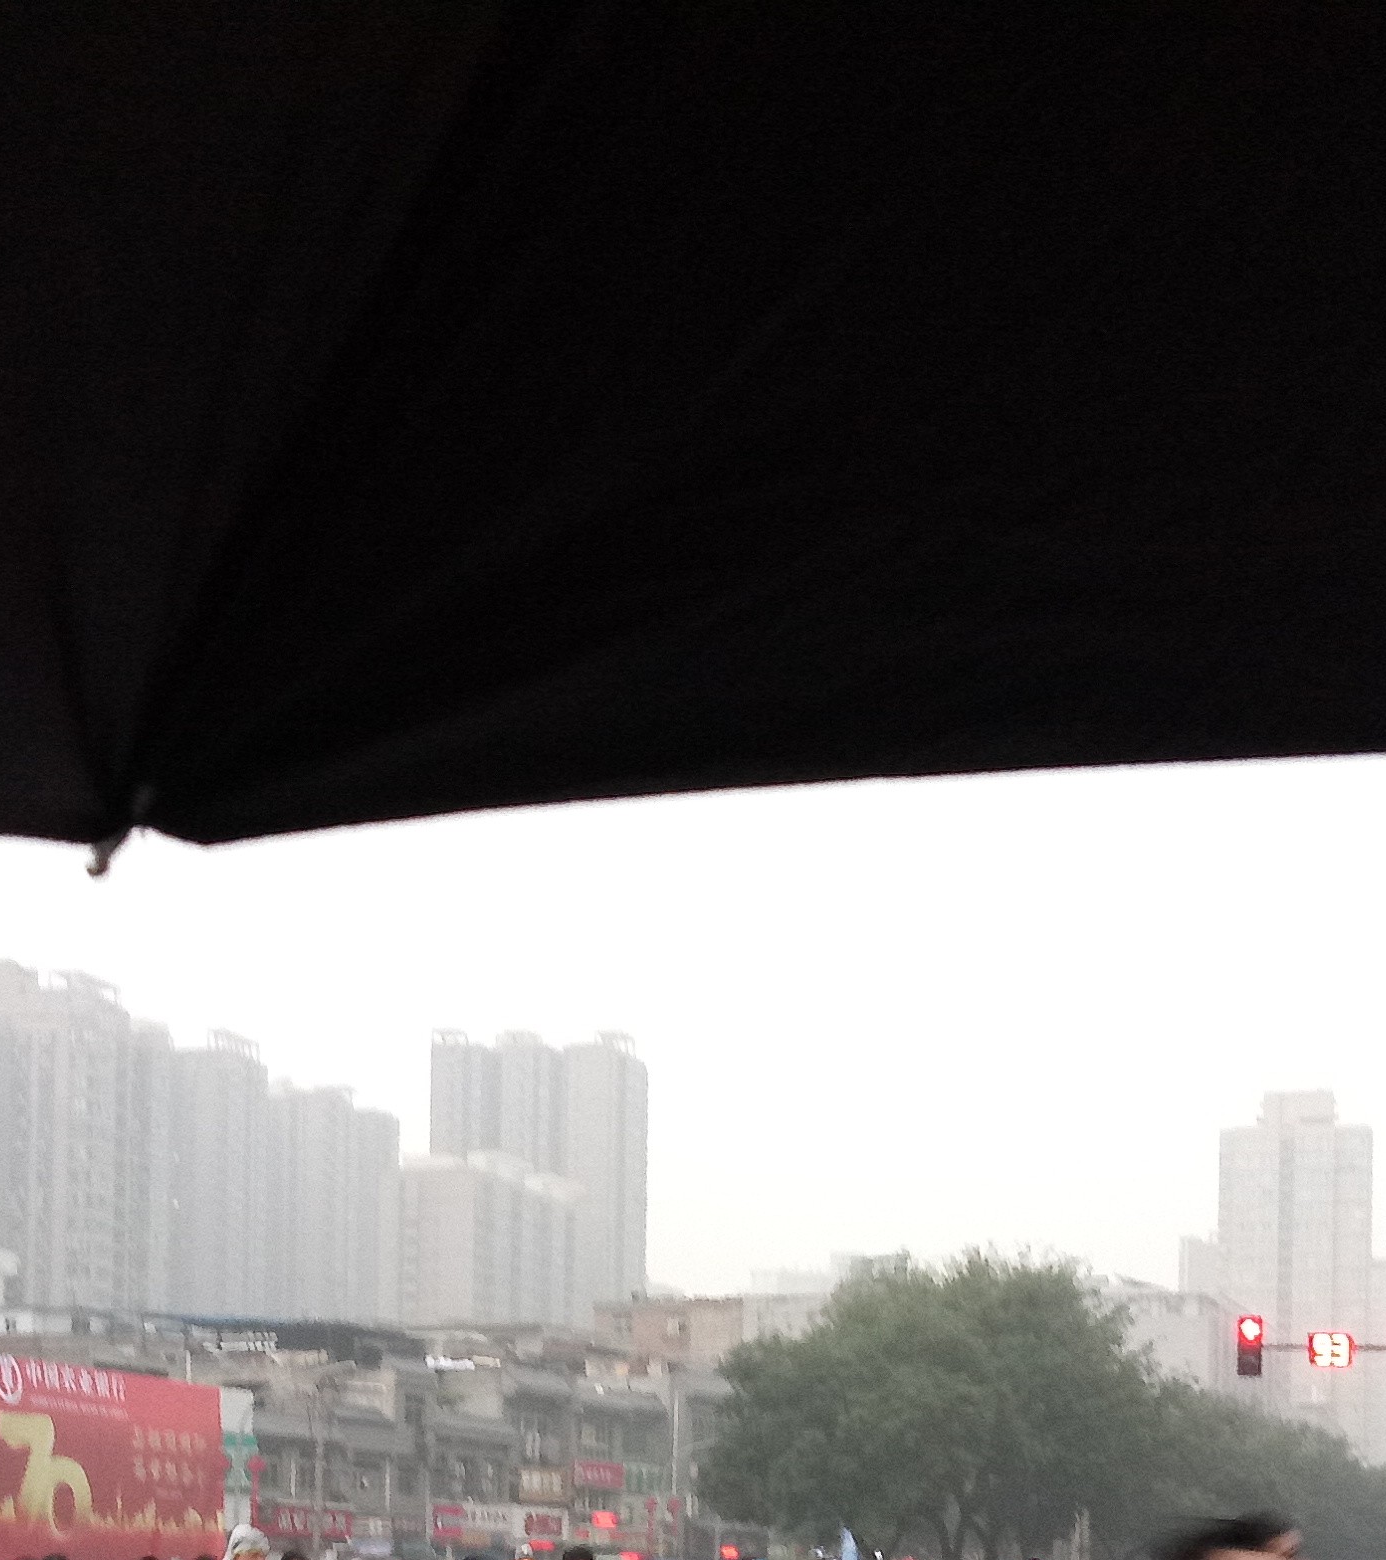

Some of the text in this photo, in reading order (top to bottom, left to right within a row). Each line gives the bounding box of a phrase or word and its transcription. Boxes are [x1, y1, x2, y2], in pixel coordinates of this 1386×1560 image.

[1312, 1333, 1351, 1368] 93
[25, 1358, 127, 1402] 中国农业银行
